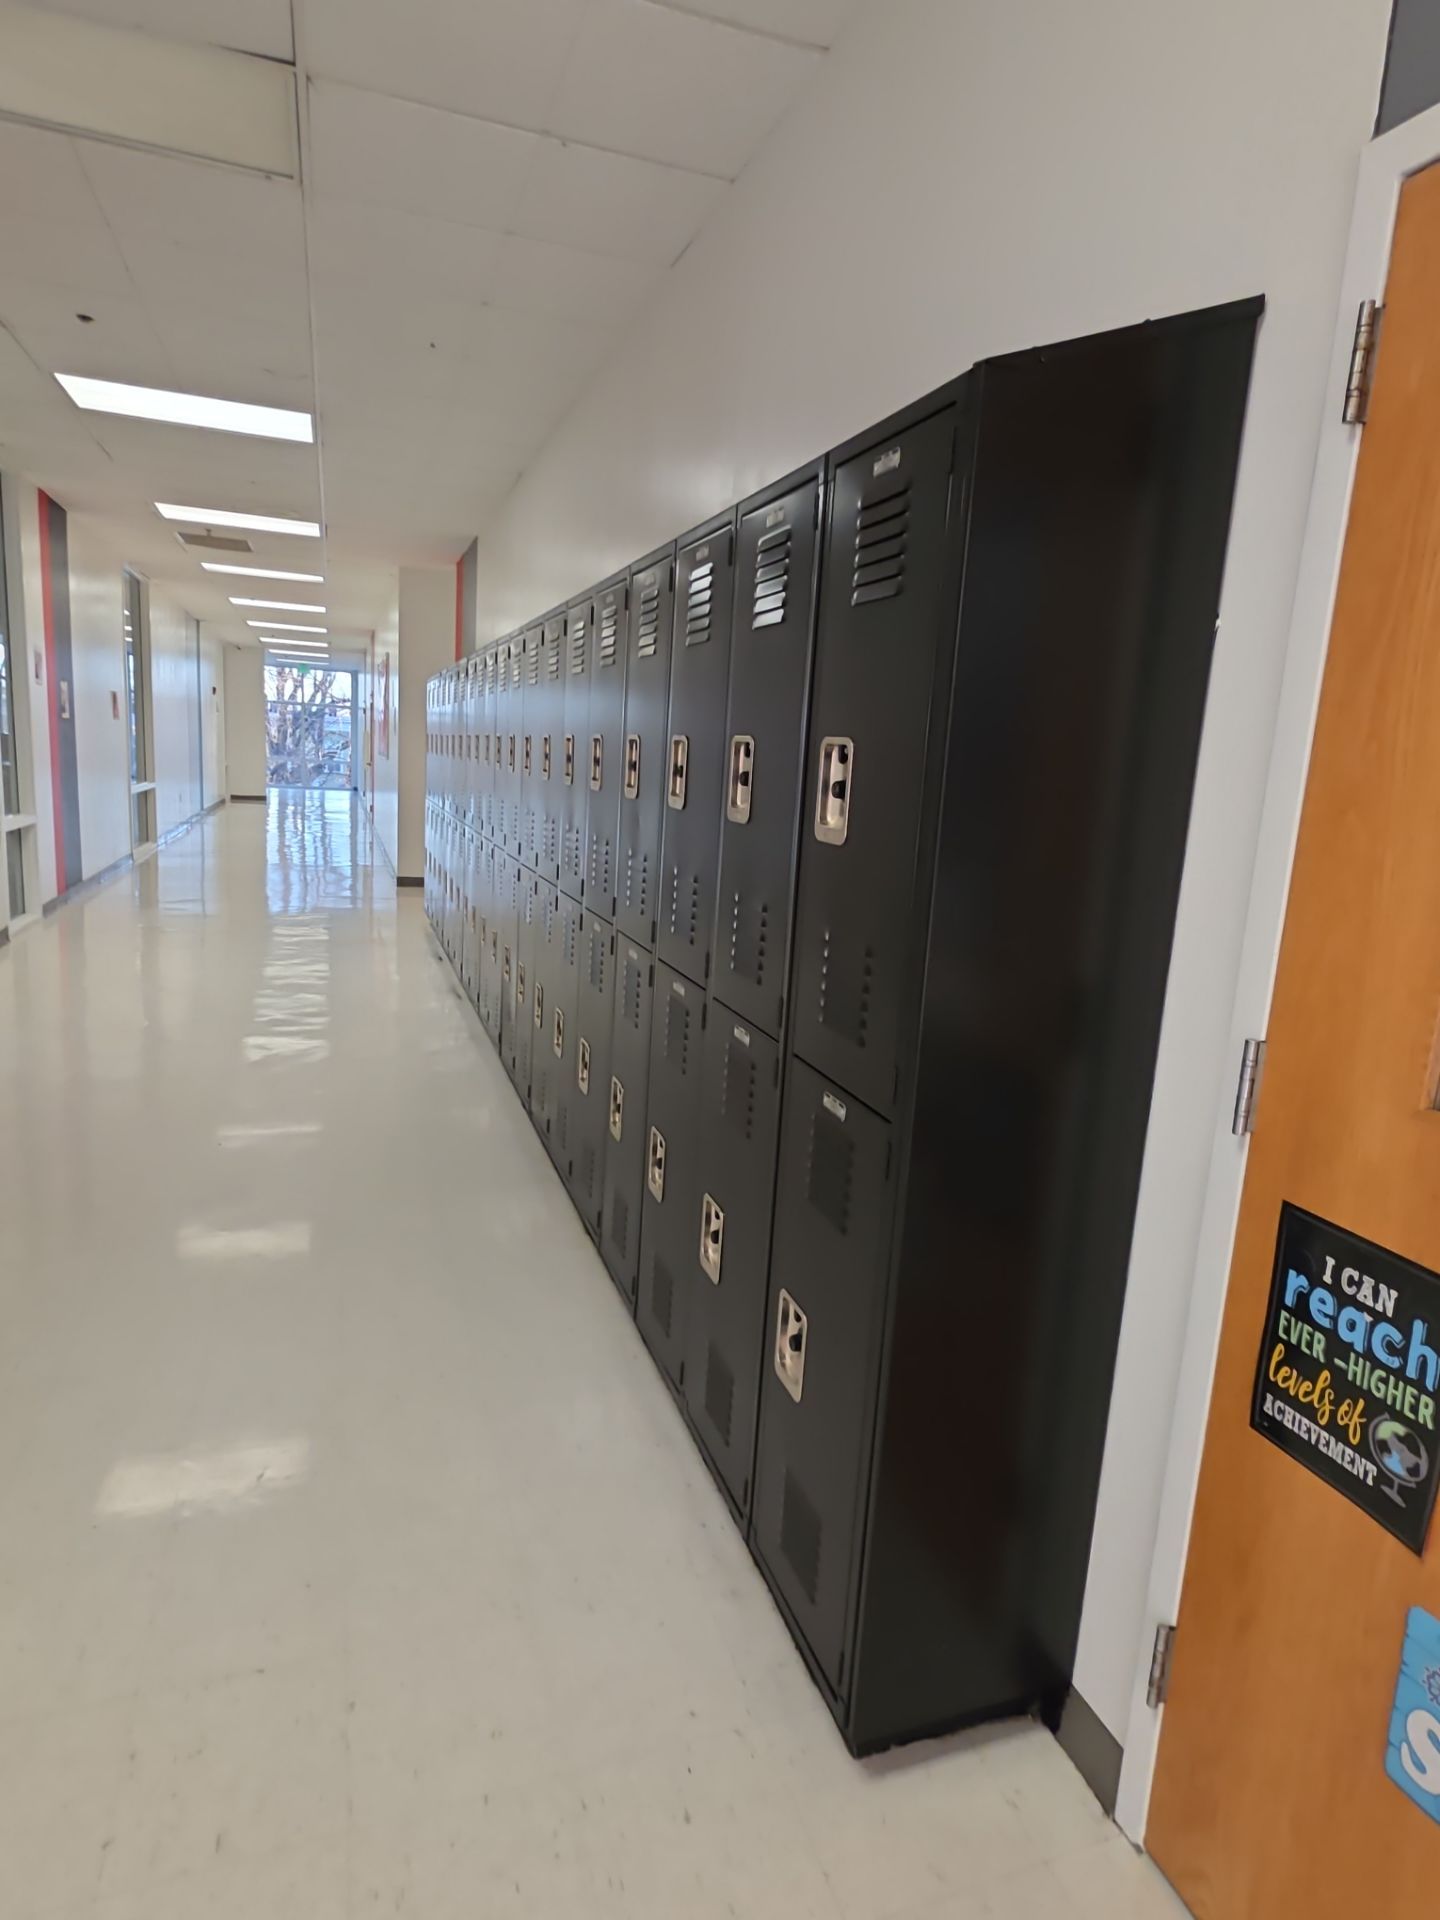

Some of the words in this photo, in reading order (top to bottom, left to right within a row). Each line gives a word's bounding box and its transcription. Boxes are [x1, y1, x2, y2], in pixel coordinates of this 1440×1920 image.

[1284, 1268, 1440, 1392] reach
[1322, 1255, 1336, 1285] I
[1341, 1267, 1399, 1318] CAN
[1278, 1309, 1328, 1363] EVER
[1263, 1392, 1377, 1486] ACHIEVEMENT
[1269, 1343, 1335, 1425] levels
[1336, 1398, 1367, 1445] of
